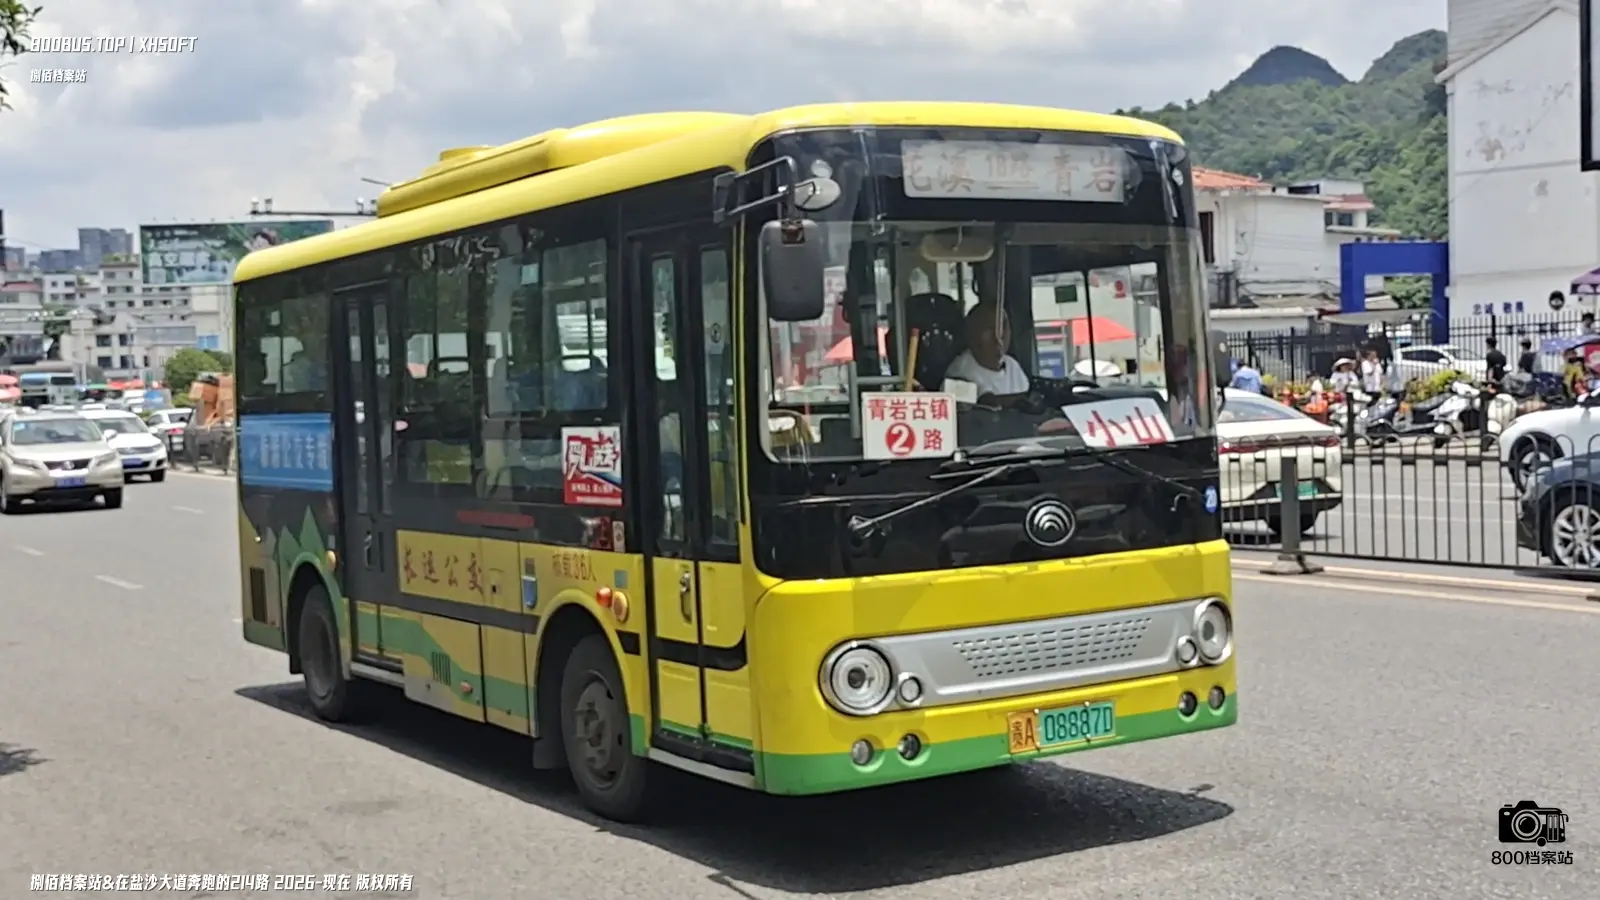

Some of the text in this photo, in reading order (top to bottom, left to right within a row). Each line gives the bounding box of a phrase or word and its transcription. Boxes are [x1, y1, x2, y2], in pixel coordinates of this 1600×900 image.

[867, 398, 949, 421] 青岩古镇
[1087, 406, 1167, 448] 小山
